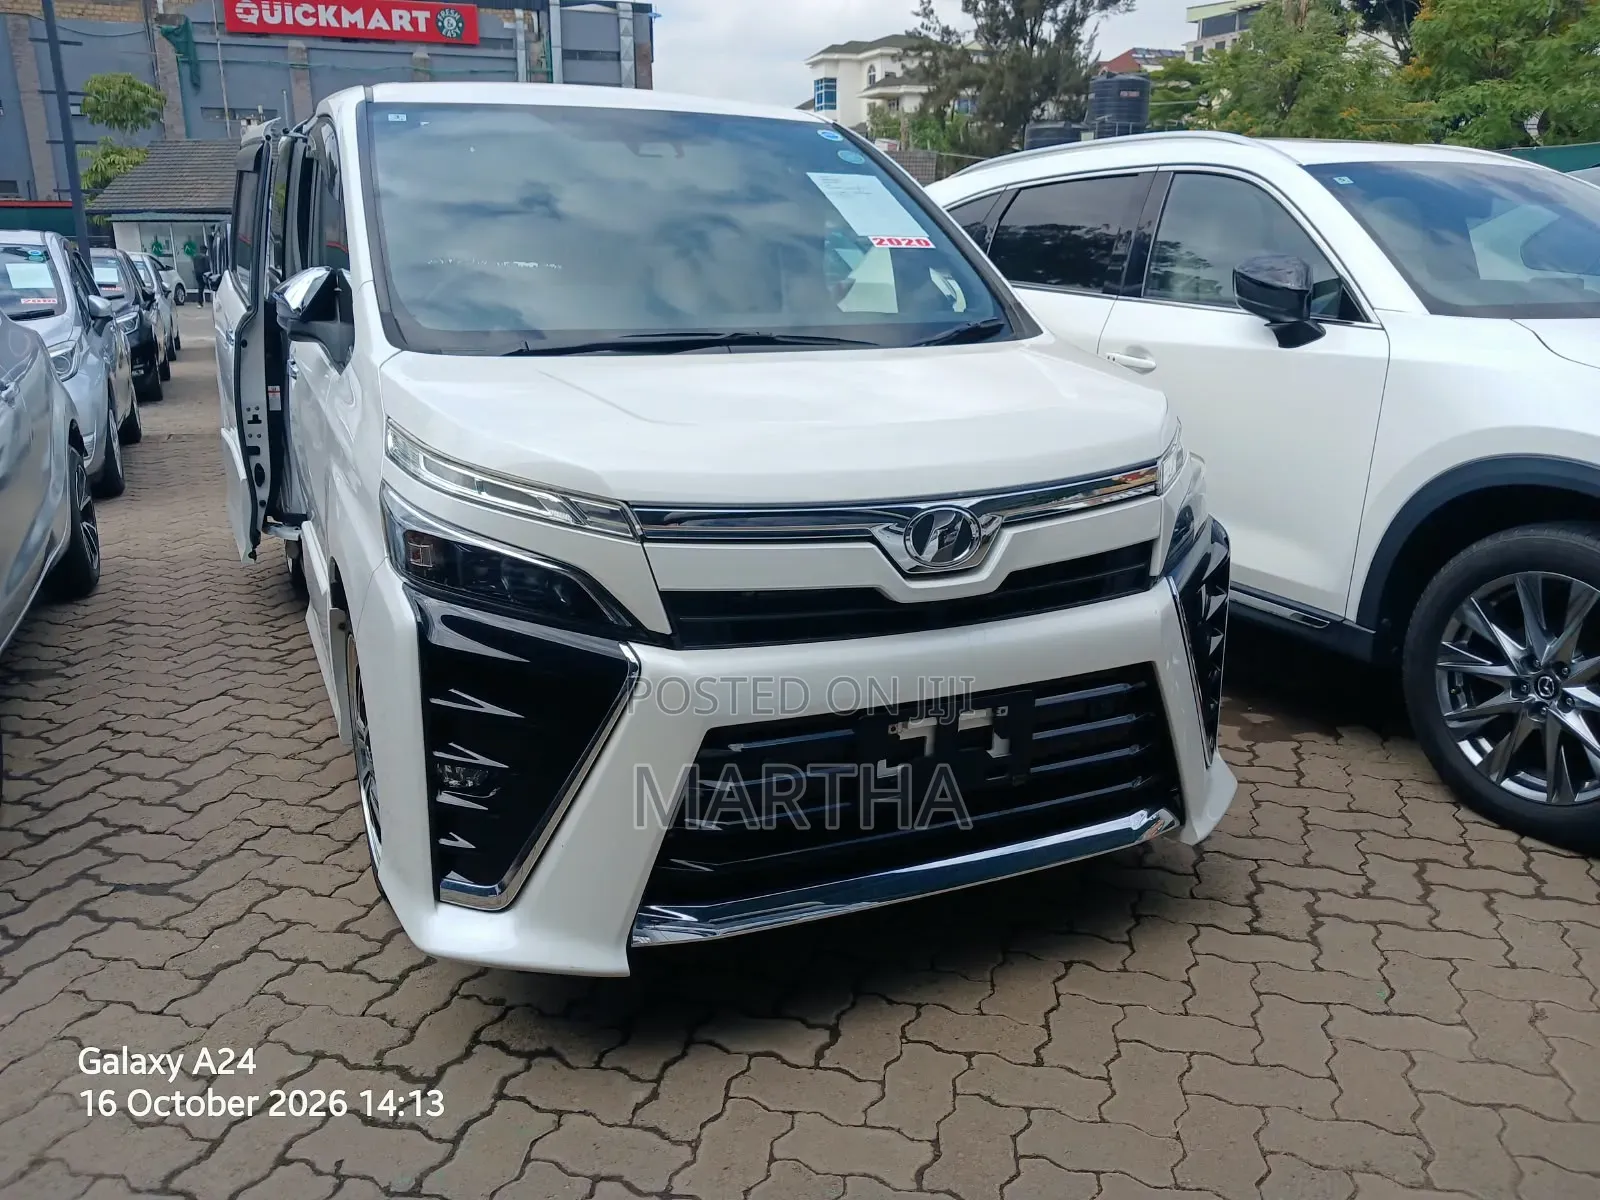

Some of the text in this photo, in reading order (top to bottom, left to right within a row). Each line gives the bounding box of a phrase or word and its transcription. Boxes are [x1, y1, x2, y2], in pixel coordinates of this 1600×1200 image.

[234, 0, 431, 32] QUICKMART
[437, 8, 461, 21] FRESH
[442, 27, 461, 38] EASY
[872, 238, 931, 246] 2020
